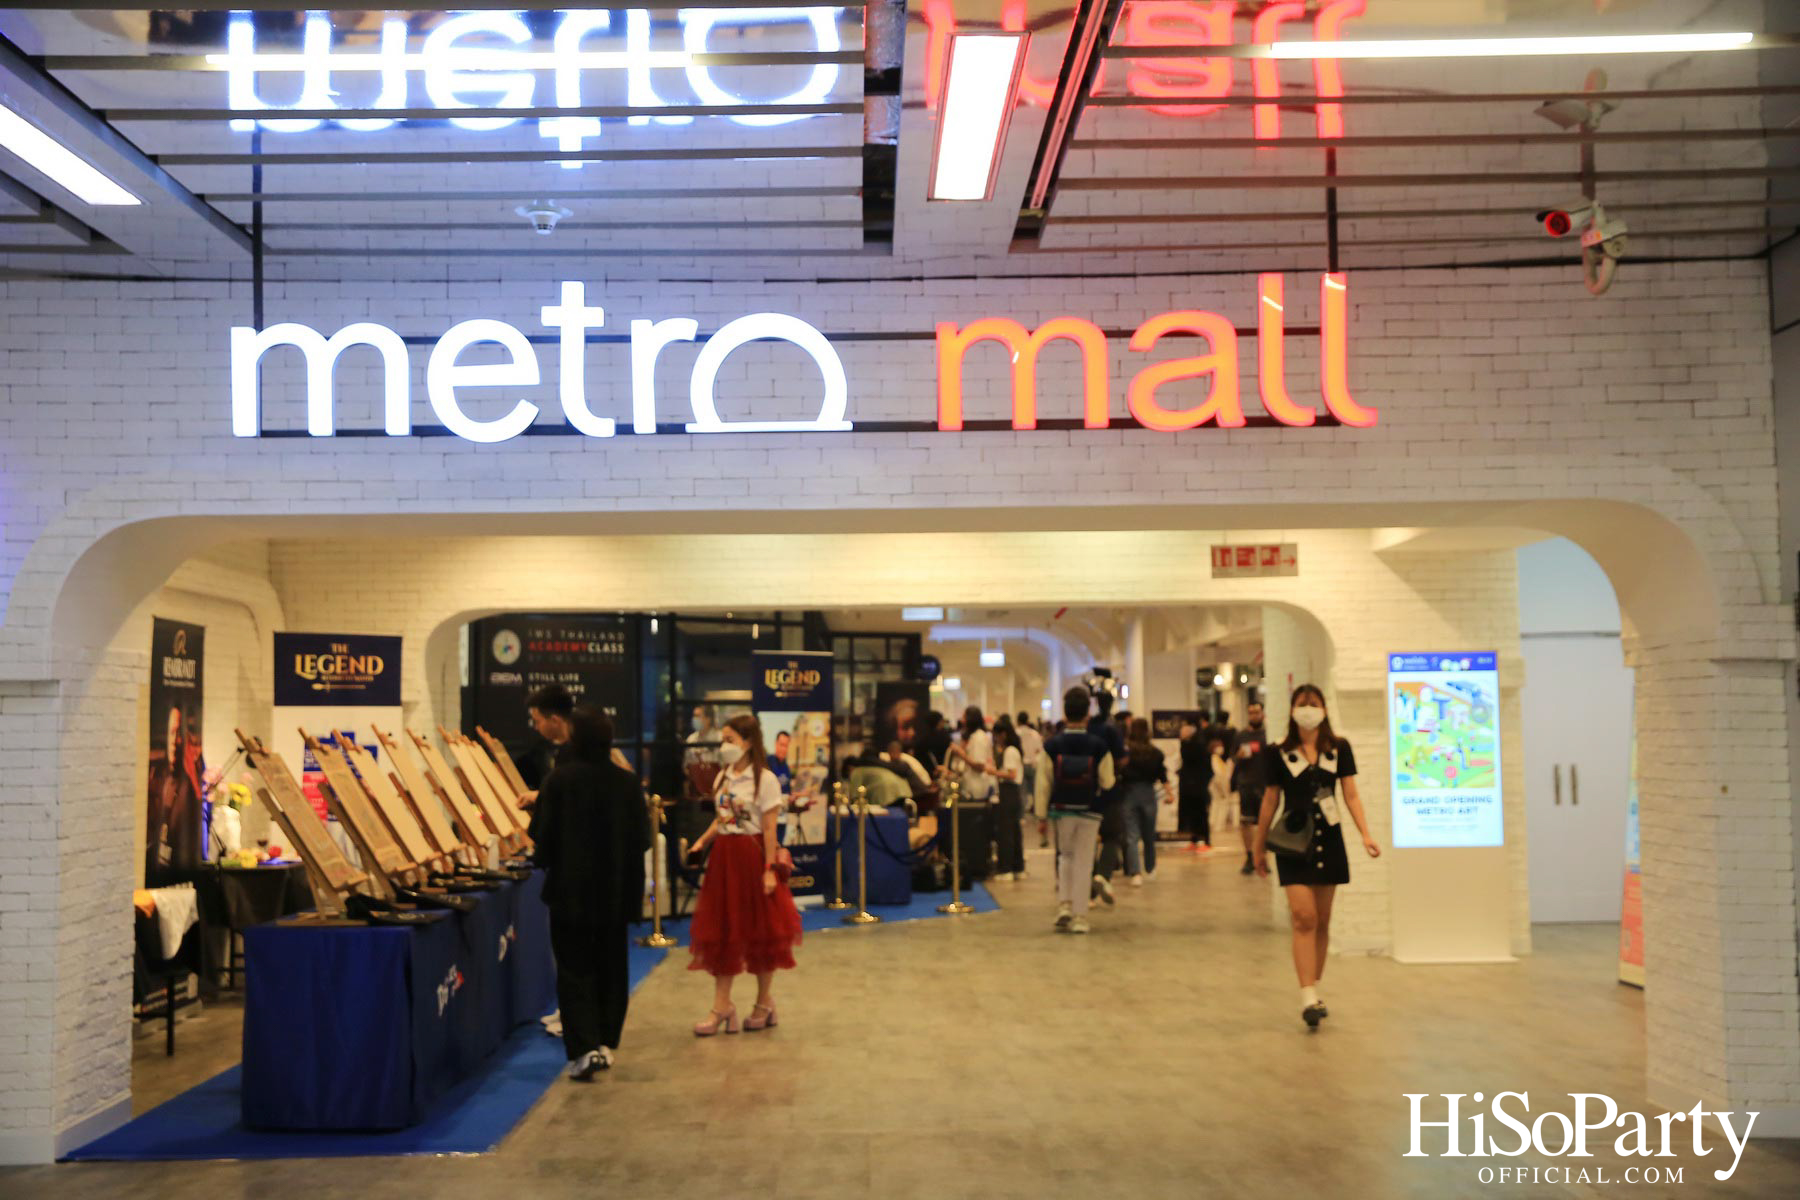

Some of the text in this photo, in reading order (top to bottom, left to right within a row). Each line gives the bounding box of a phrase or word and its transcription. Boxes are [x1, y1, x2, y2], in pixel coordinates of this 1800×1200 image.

[230, 272, 1378, 443] metro mall
[294, 654, 384, 680] LEGEND
[764, 669, 821, 690] LEGEND
